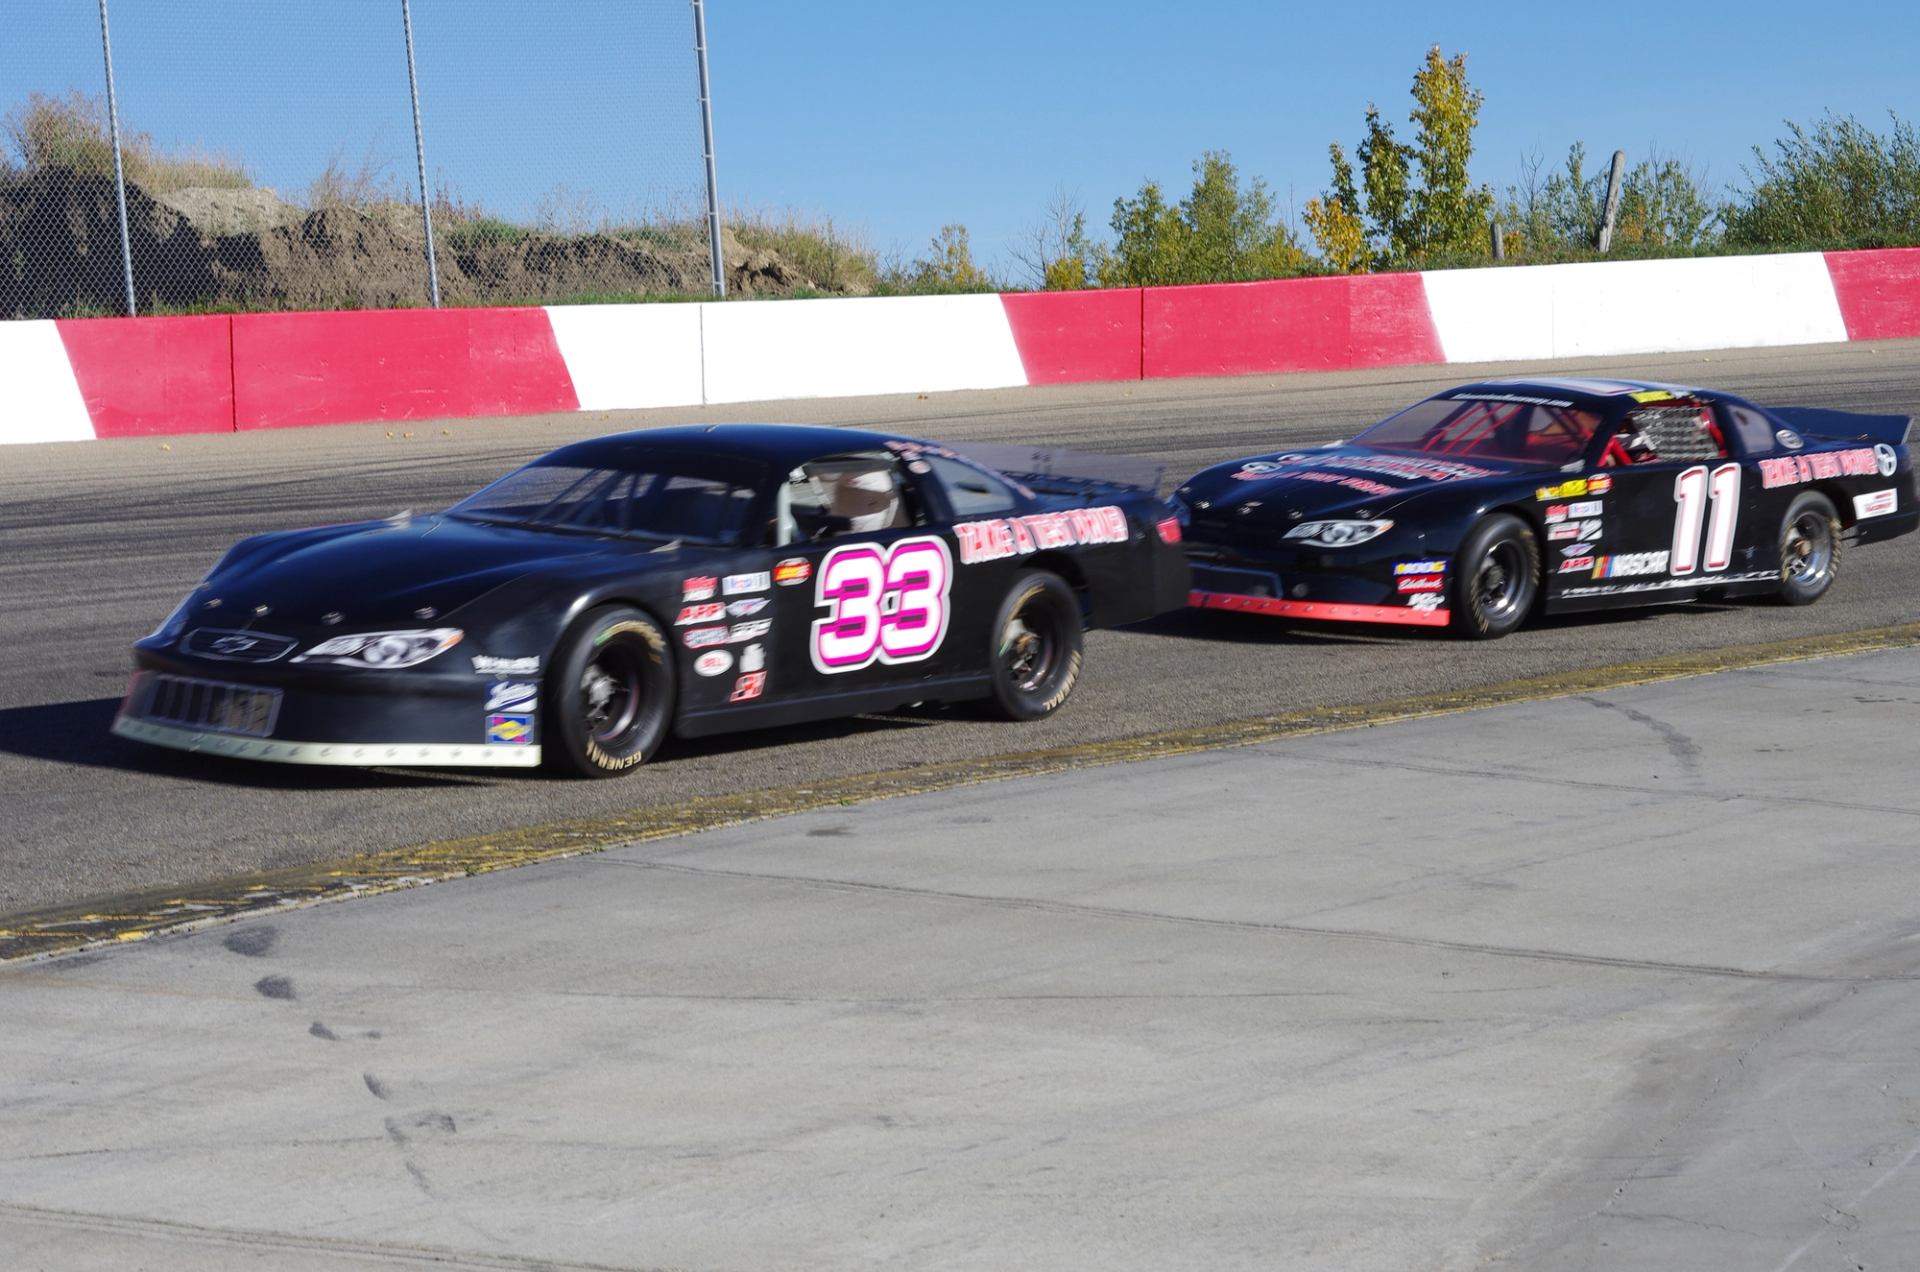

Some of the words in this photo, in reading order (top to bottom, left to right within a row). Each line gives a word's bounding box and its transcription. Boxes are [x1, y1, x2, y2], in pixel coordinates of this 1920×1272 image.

[1008, 517, 1037, 555] A
[1018, 511, 1077, 550] TEST
[1670, 463, 1741, 576] 11
[952, 518, 1017, 565] TAKE
[1612, 550, 1670, 577] NASCAR
[675, 602, 725, 622] ARP
[809, 535, 954, 675] 33
